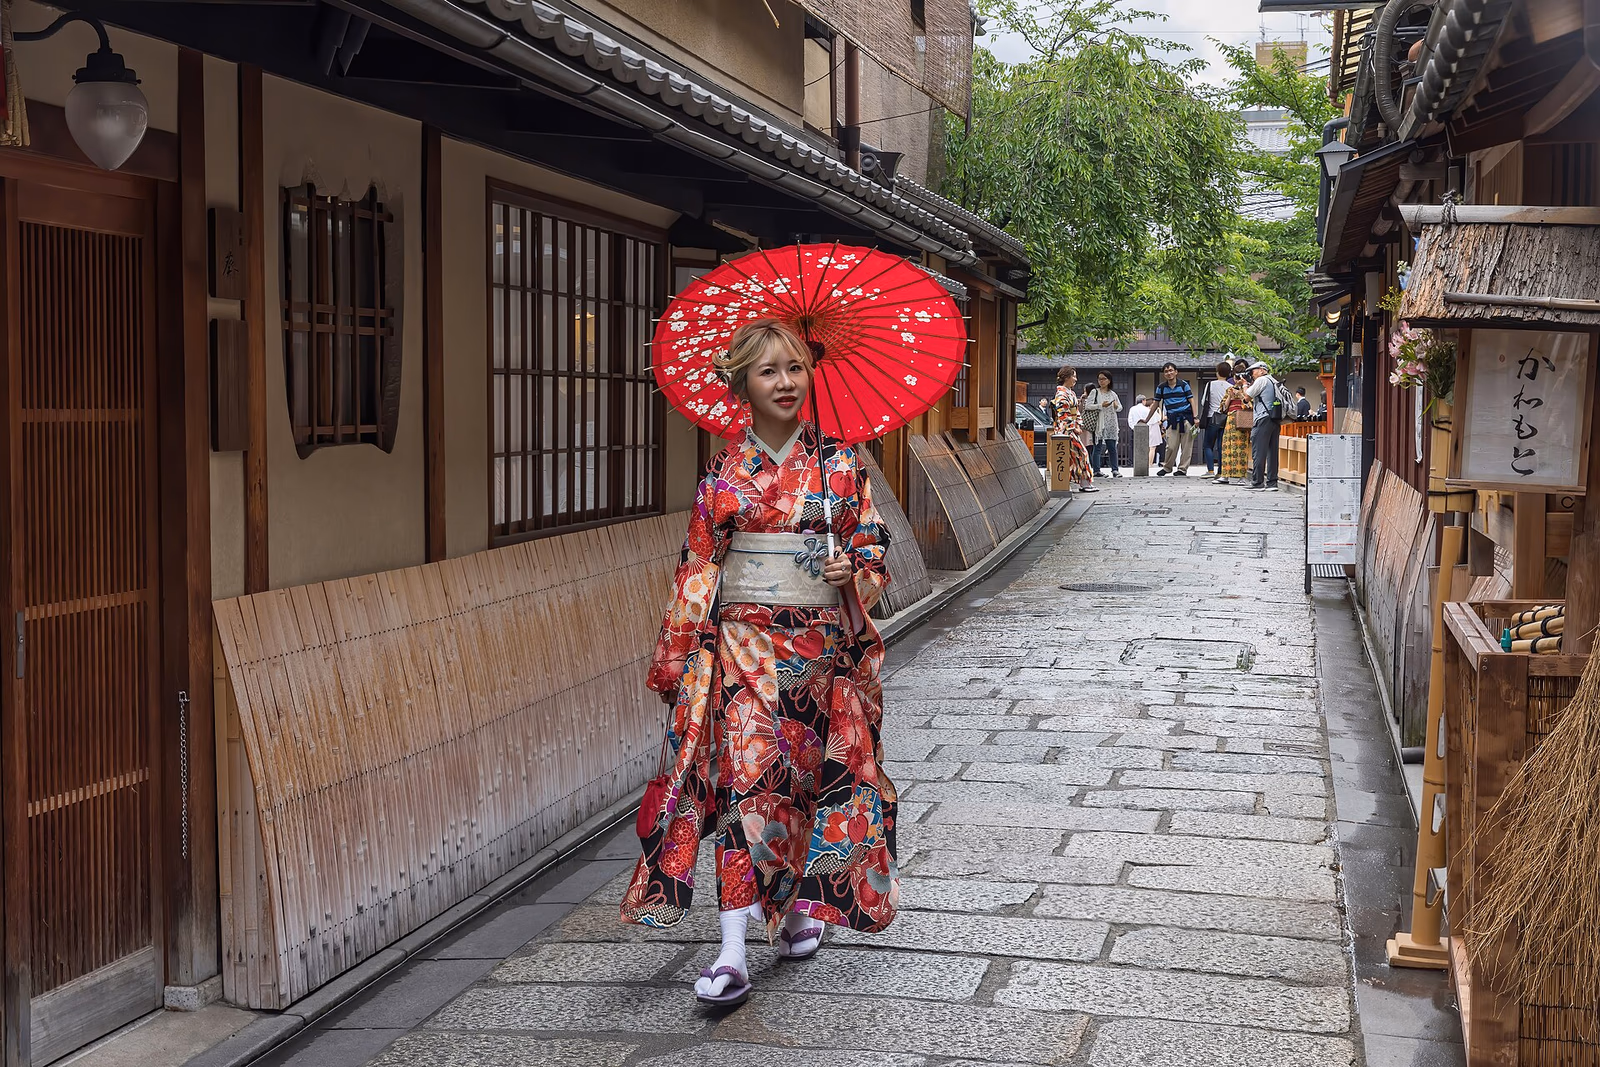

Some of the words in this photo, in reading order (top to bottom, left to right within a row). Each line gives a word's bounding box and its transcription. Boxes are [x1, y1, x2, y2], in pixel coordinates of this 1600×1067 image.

[1511, 348, 1555, 477] かわもと
[1056, 442, 1065, 481] たつみはし
